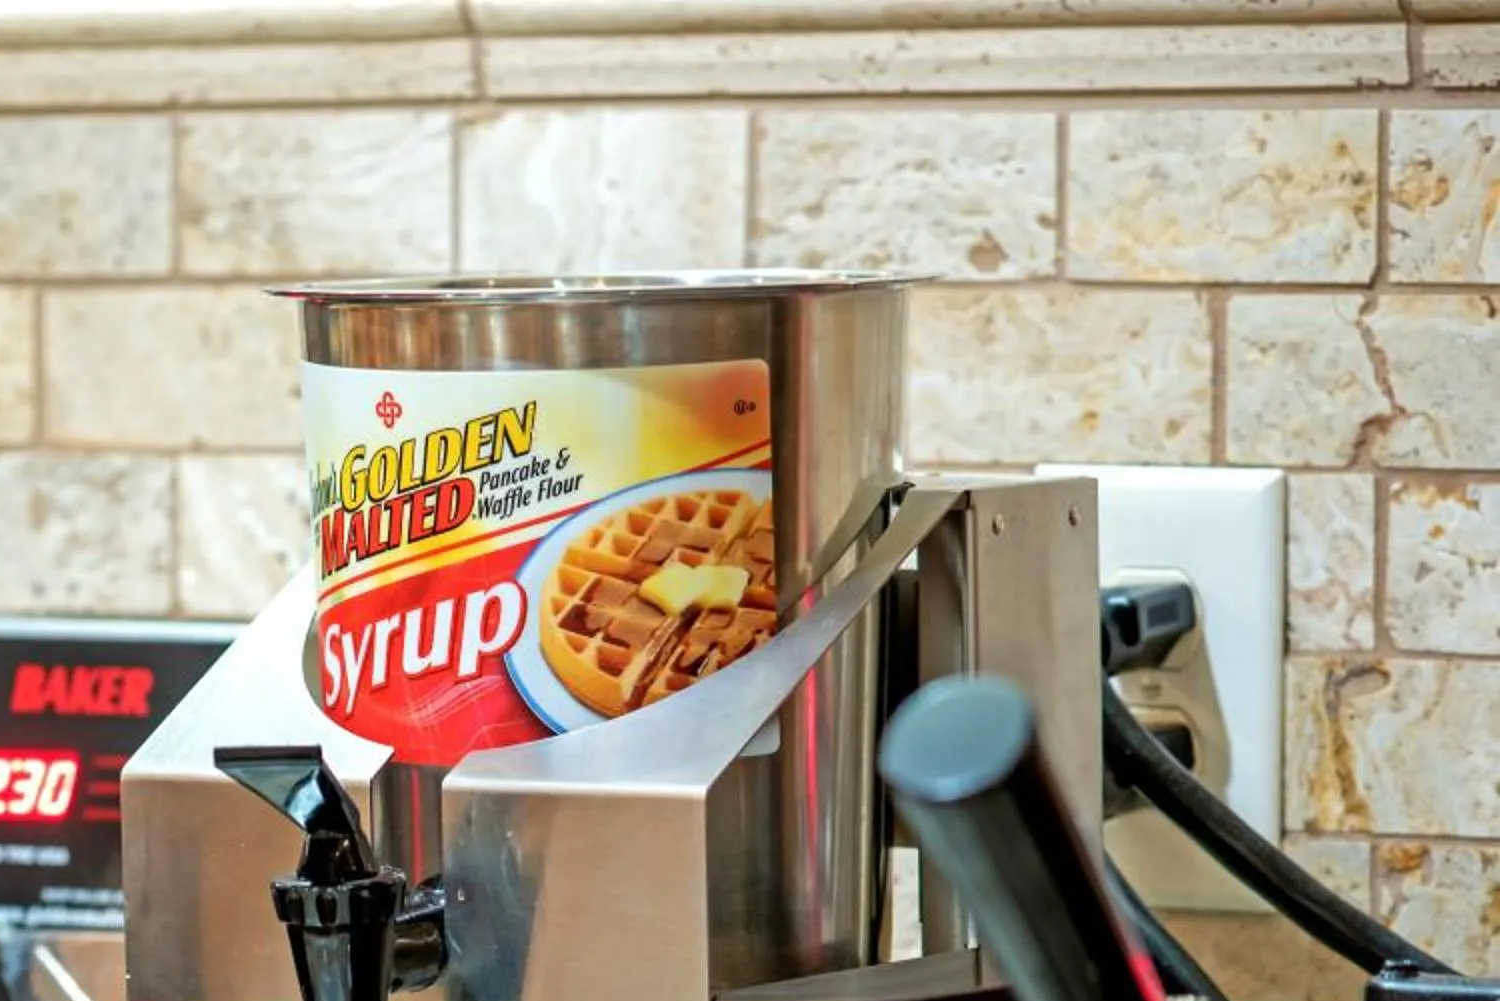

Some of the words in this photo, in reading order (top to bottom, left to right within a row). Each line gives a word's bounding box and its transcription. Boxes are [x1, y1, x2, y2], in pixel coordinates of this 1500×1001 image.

[340, 401, 536, 512] GOLDEN
[479, 456, 551, 493] Pancake
[556, 447, 571, 470] &
[322, 477, 476, 580] MALTED
[477, 486, 533, 520] Waffle
[537, 473, 585, 503] Flour
[324, 582, 524, 715] Syrup
[11, 663, 155, 717] BAKER
